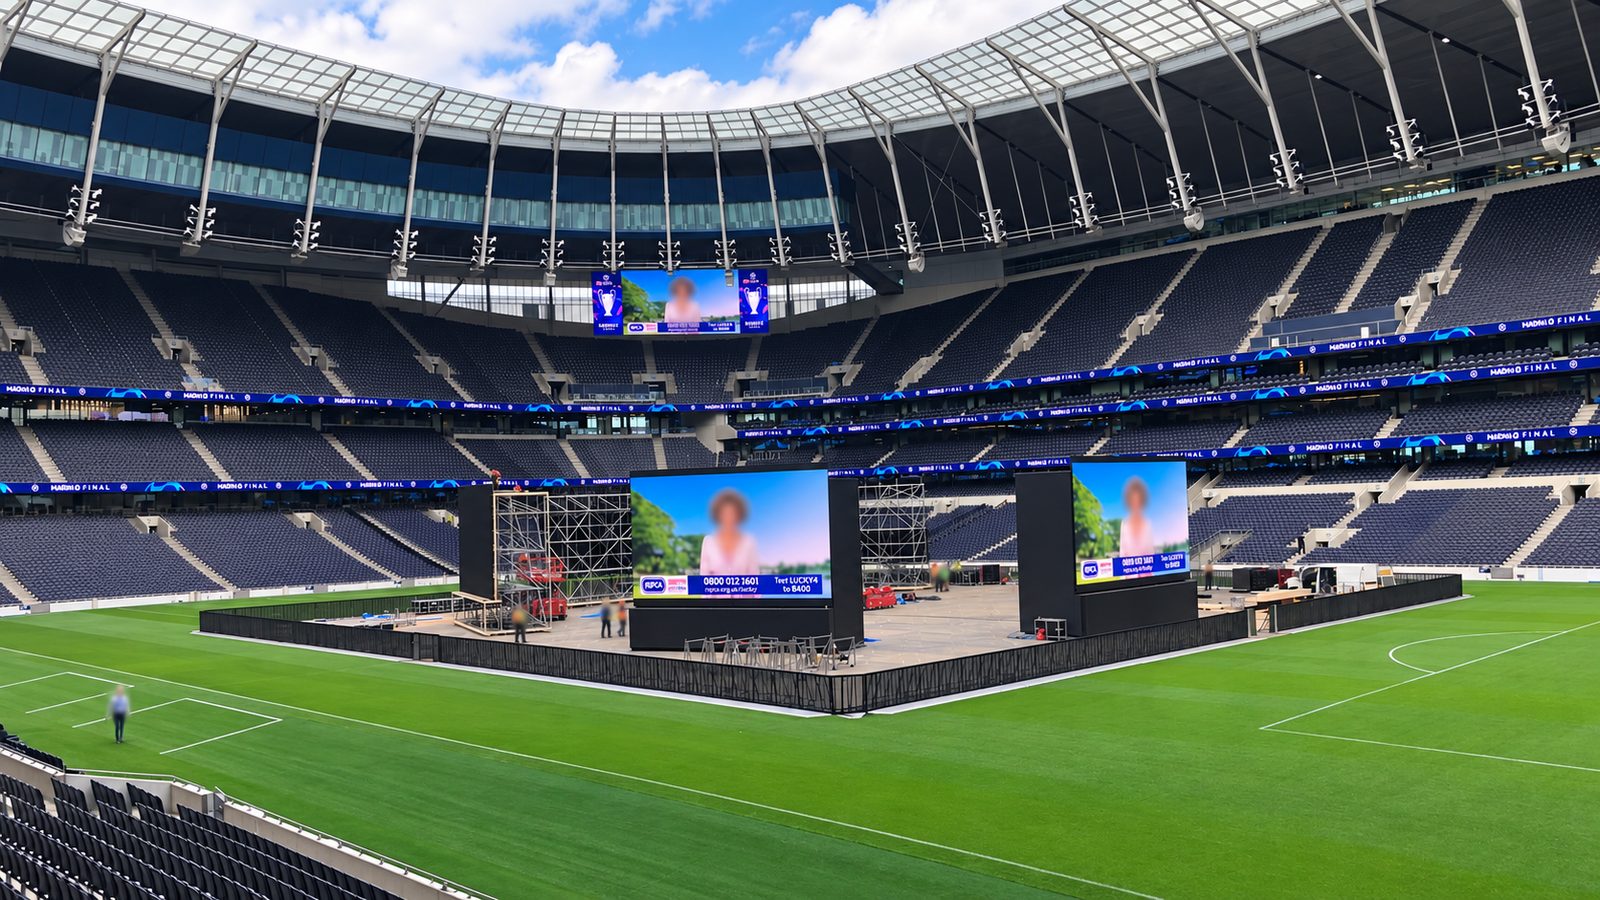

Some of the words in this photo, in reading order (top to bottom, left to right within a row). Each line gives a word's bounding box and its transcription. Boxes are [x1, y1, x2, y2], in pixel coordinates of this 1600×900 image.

[1557, 314, 1591, 324] FINAL
[1358, 338, 1387, 347] FINAL
[1197, 356, 1220, 364] FINAL
[1524, 362, 1557, 372] FINAL
[1344, 381, 1371, 389] FINAL
[1522, 430, 1555, 438] FINAL
[1335, 442, 1362, 450] FINAL
[704, 577, 724, 585] 0800
[725, 577, 740, 585] 012
[741, 577, 759, 585] 1601
